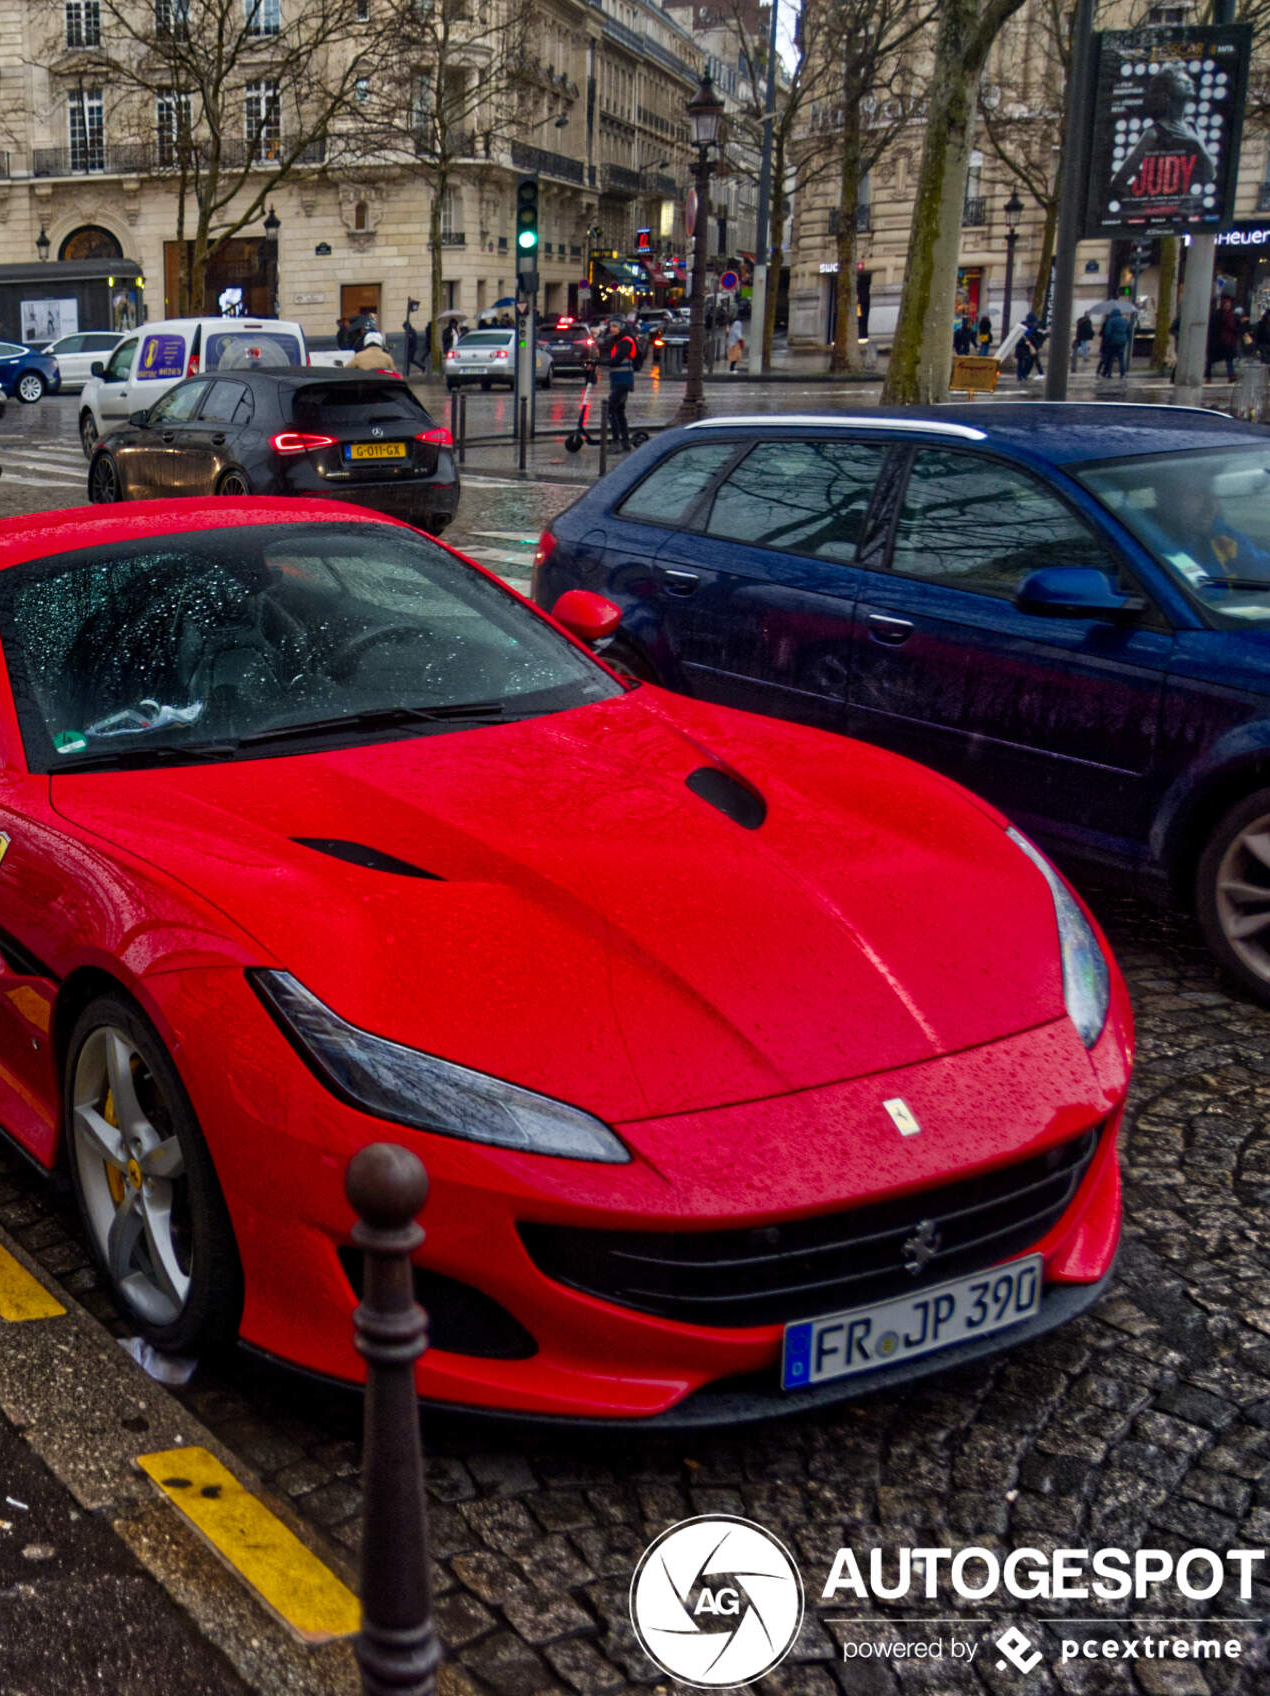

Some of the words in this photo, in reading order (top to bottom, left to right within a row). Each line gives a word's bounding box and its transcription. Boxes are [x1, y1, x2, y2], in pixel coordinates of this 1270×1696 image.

[1131, 154, 1198, 196] JUDY
[357, 444, 400, 457] G-011-GX
[815, 1318, 873, 1372] FR
[903, 1293, 956, 1348] JP
[966, 1266, 1037, 1329] 390
